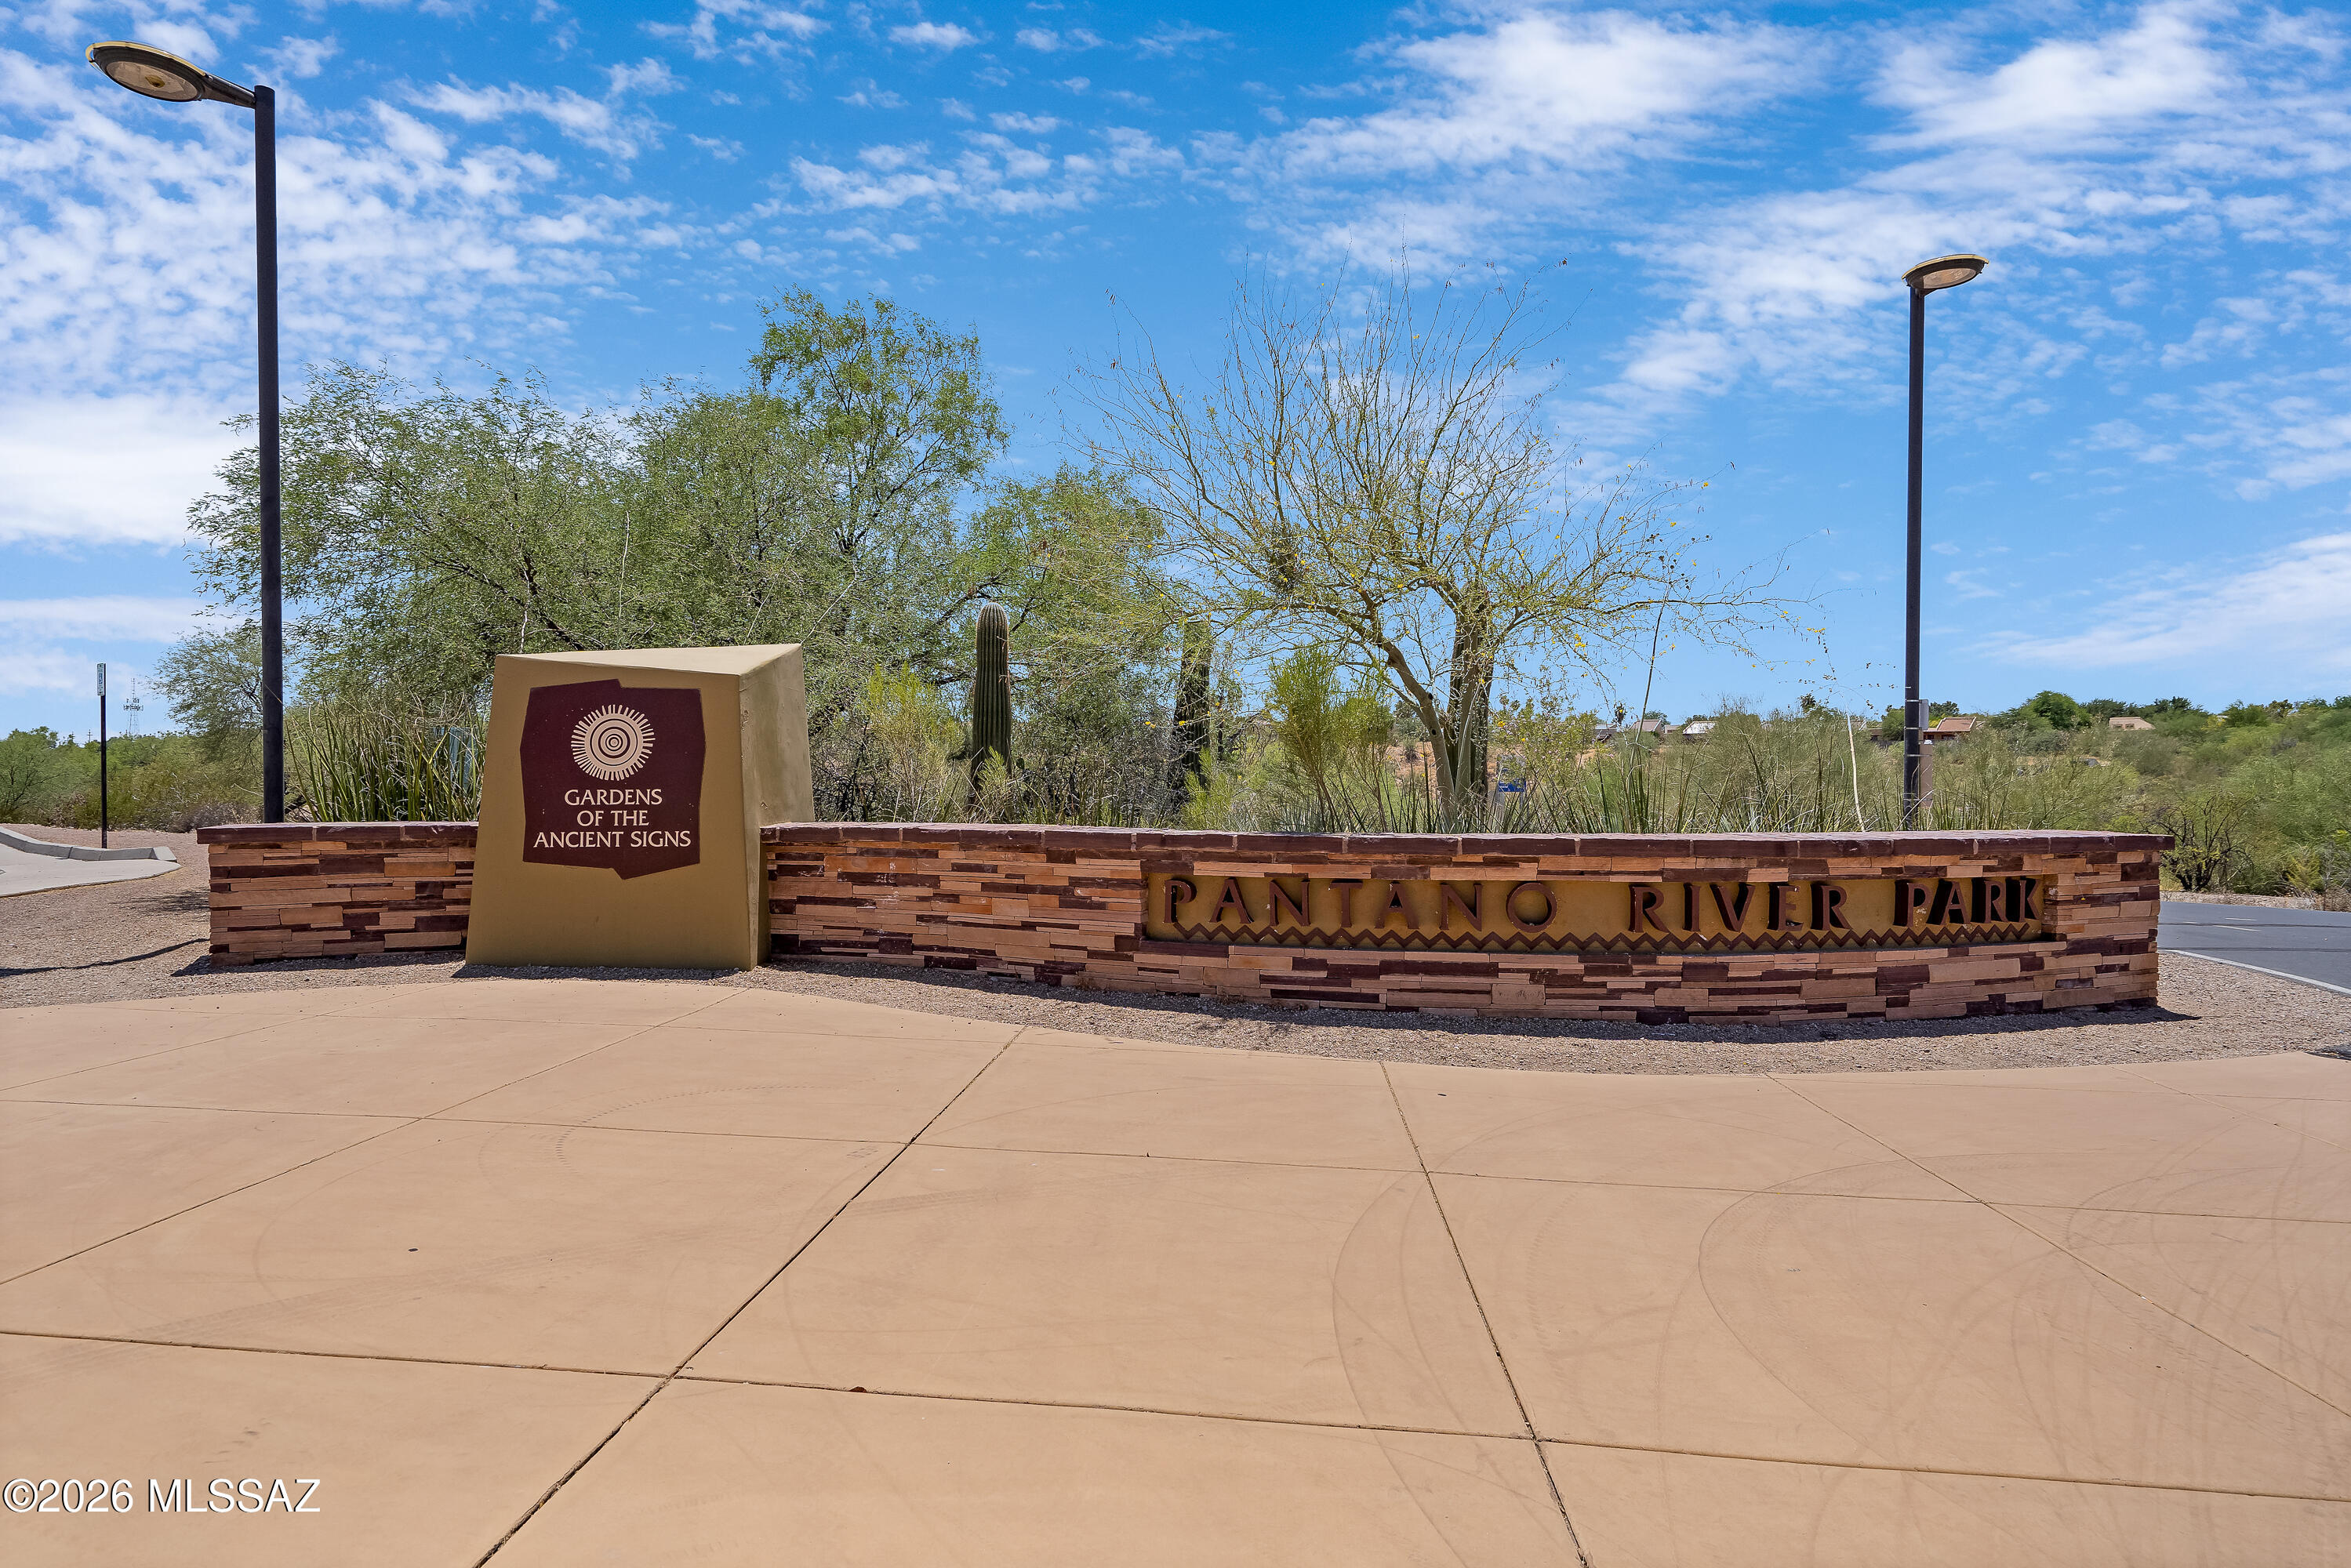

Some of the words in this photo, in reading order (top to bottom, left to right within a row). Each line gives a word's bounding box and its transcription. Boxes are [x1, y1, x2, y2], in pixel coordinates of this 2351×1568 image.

[564, 788, 663, 806] GARDENS
[576, 810, 604, 826] OF
[611, 810, 649, 826] THE
[533, 831, 623, 848] ANCIENT
[630, 830, 692, 848] SIGNS
[1163, 877, 1558, 933] PANTANO
[1629, 881, 1852, 933] RIVER
[1893, 876, 2042, 927] PARK
